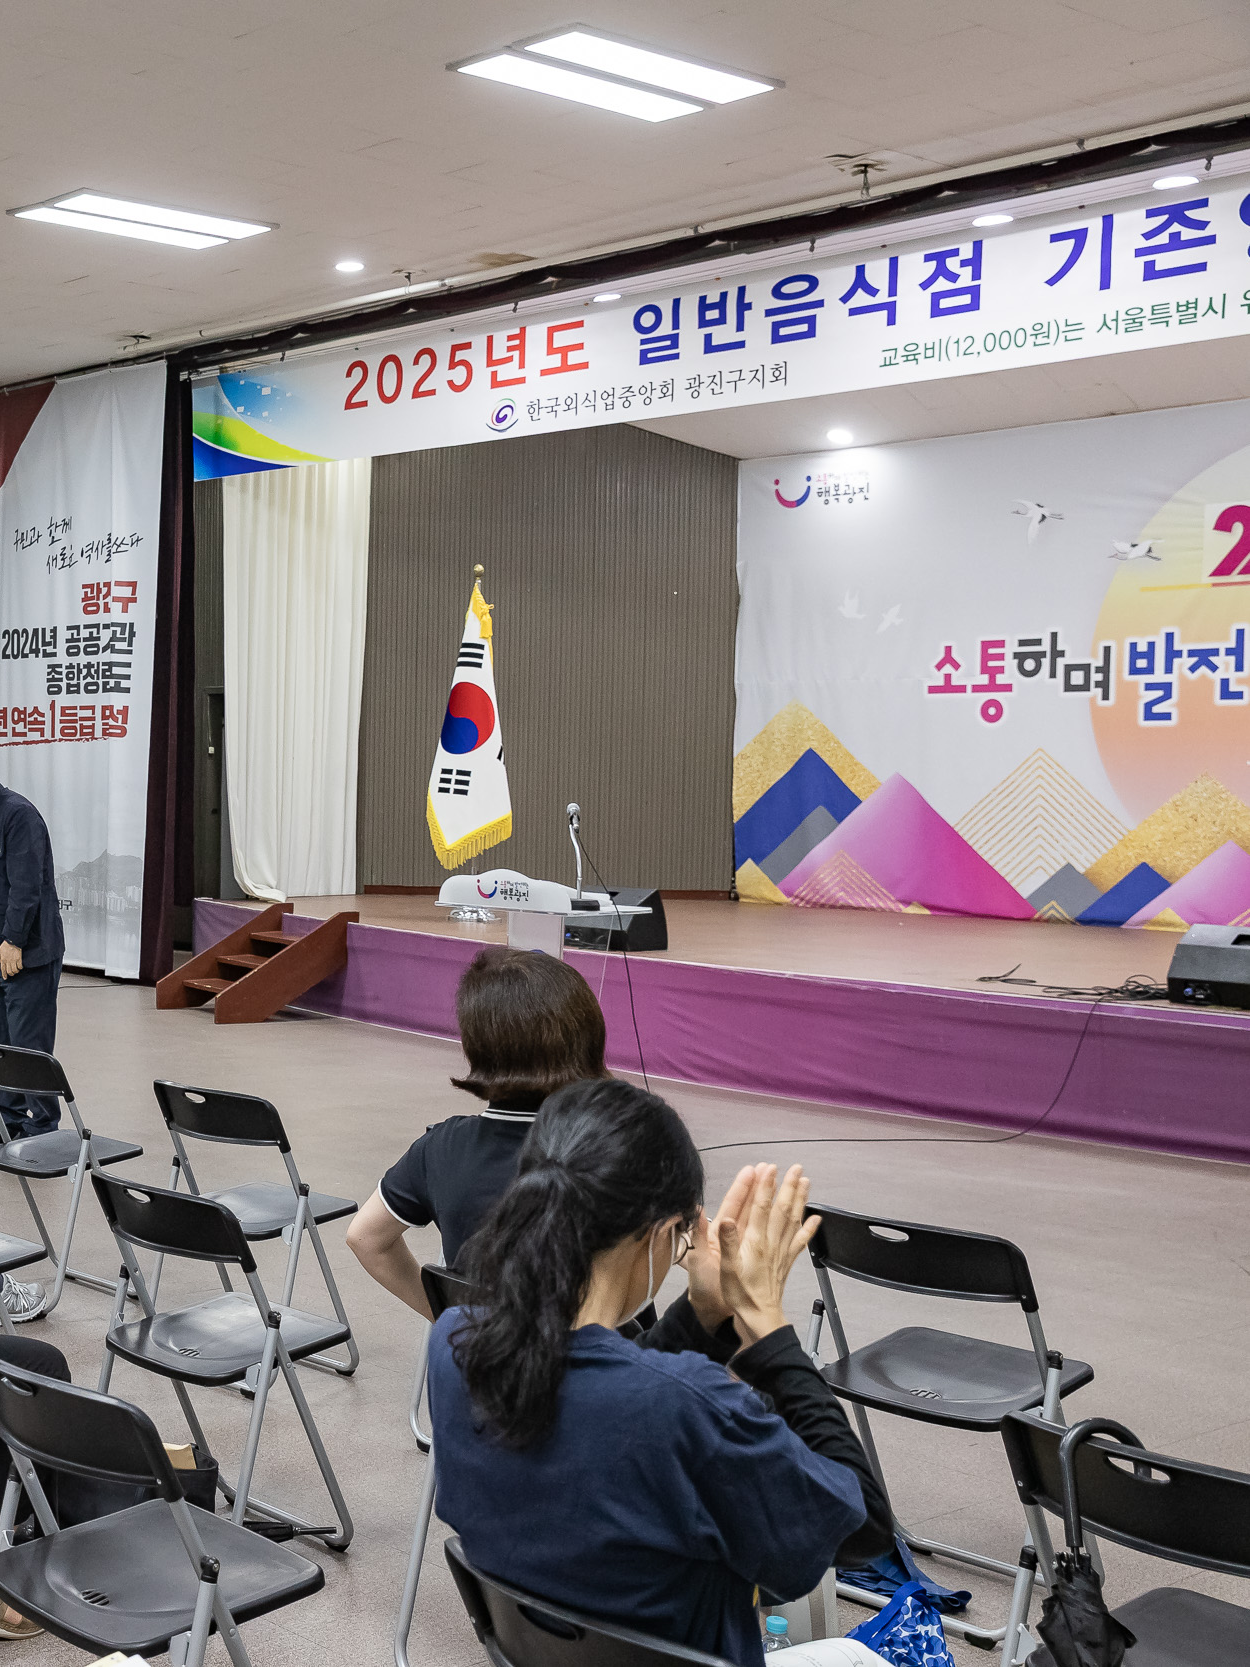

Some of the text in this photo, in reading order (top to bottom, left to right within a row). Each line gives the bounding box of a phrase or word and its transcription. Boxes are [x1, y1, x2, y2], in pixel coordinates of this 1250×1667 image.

[344, 319, 590, 411] 2025년도
[633, 239, 984, 366] 일반음식점
[879, 317, 1085, 368] 교육비(12,000원)는
[1097, 292, 1227, 335] 서울특별시
[526, 360, 788, 422] 한국외식업중앙회 광진구지회
[1, 625, 58, 660] 2024년
[927, 628, 1245, 724] 소통하며 발전
